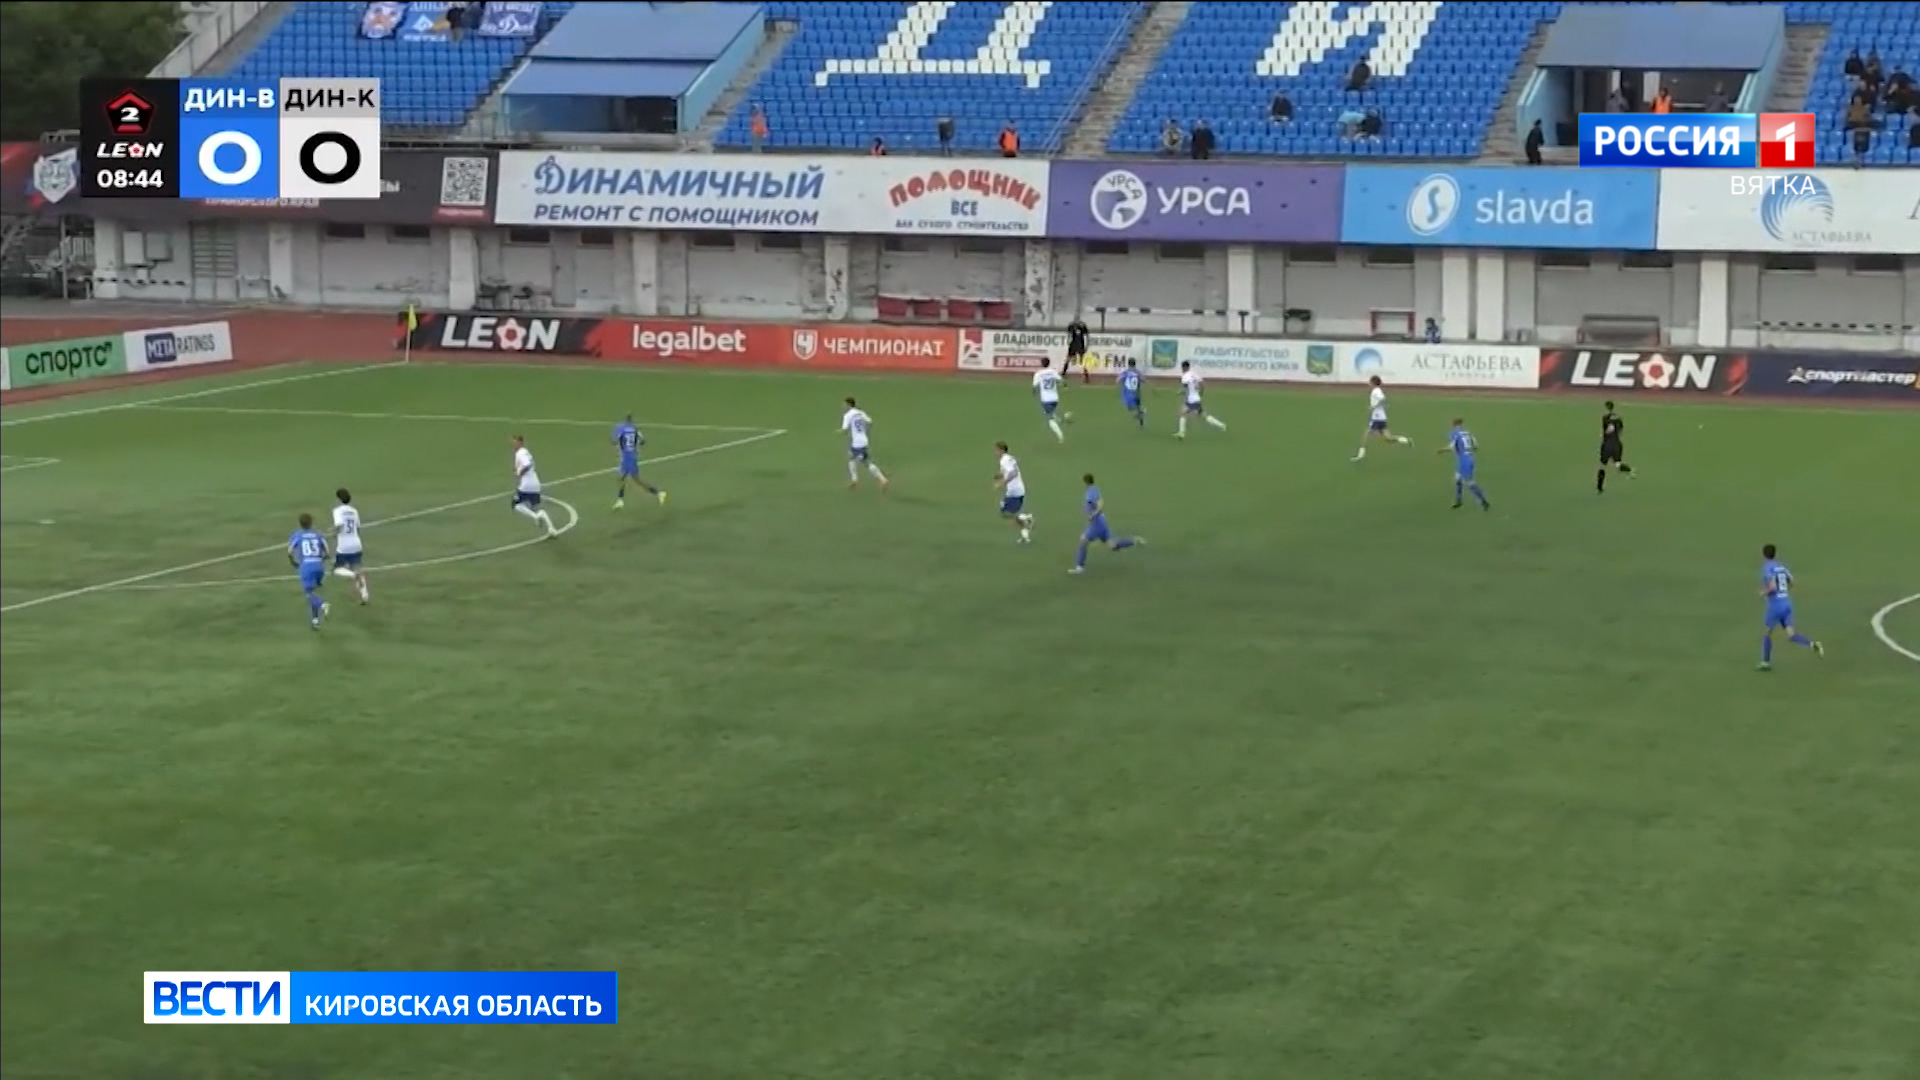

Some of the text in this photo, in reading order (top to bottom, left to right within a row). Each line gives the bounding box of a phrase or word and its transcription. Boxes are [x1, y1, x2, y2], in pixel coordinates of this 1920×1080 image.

[533, 155, 825, 200] ДИНАМИЧНЫЙ
[889, 169, 1041, 211] ПОМОЩНИК
[533, 204, 819, 226] РЕМОНТ С ПОМОЩНИКОМ
[951, 200, 978, 216] ВСЕ
[1157, 186, 1250, 216] УРСА
[1475, 190, 1594, 225] slavda
[441, 316, 560, 350] LEON
[633, 324, 746, 357] legalbet
[823, 337, 944, 356] ЧЕМПИОНАТ
[1411, 353, 1523, 370] АСТАФЬЕВА
[1570, 351, 1717, 389] LEON
